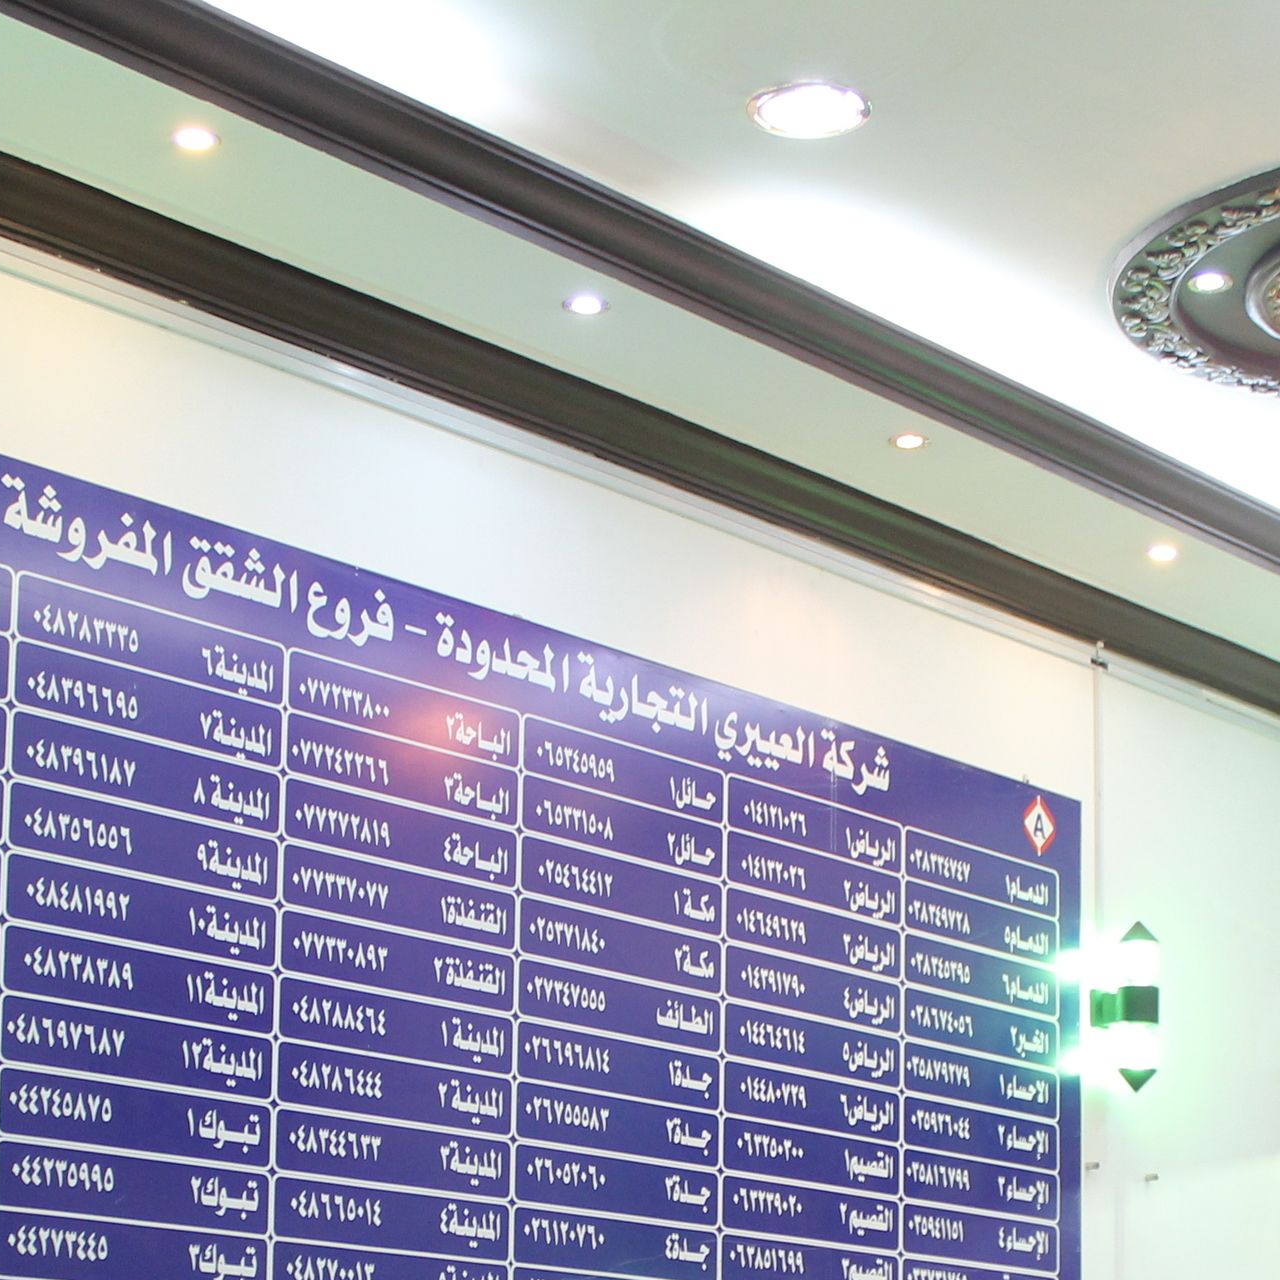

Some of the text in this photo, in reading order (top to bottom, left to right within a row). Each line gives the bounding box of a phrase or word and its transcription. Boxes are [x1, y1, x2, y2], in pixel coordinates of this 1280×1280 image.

[1, 474, 891, 795] شركة العييري التجارية المحدودة فروع الشقق المفروشة
[34, 604, 138, 652] ٠٤٨٢٨٣٣٣٥
[28, 671, 138, 719] ٠٤٨٣٩٦٦٩٥
[299, 677, 389, 719] ٠٧٧٢٣٣٨٠٠
[27, 739, 135, 786] ٠٤٨٣٩٦١٨٧
[292, 739, 389, 785] ٠٧٧٢٤٢٢٦٦
[537, 741, 615, 782] ٠٦٥٣٤٥٩٥٩
[25, 808, 132, 855] ٠٤٨٣٥٦٥٥٦
[295, 803, 390, 847] ٠٧٧٢٧٢٨١٩
[536, 800, 613, 840] ٠٦٥٣٣١٥٠٨
[292, 866, 388, 909] ٠٧٧٣٣٧٠٧٧
[539, 859, 613, 897] ٠٢٥٤٦٤٤١٢
[27, 877, 130, 920] ٠٤٨٤٨١٩٩٢
[293, 931, 388, 971] ٠٧٧٣٣٠٨٩٣
[530, 917, 605, 954] ٠٢٥٣٧١٨٤٠
[24, 946, 133, 990] ٠٤٨٢٣٨٣٨٩
[527, 976, 605, 1011] ٠٢٧٣٤٧٥٥٥
[7, 1014, 125, 1056] ٠٤٨٦٩٧٦٨٧
[292, 995, 386, 1035] ٠٤٨٢٨٨٤٦٤
[525, 1036, 609, 1073] ٠٢٦٦٩٦٨١٤
[292, 1060, 382, 1098] ٠٤٨٢٨٦٤٤٤
[10, 1084, 112, 1122] ٠٤٤٢٤٥٨٧٥
[526, 1096, 609, 1131] ٠٢٦٧٥٥٥٨٣
[289, 1125, 381, 1161] ٠٤٨٣٤٤٦٣٣
[12, 1155, 114, 1192] ٠٤٤٢٣٥٩٩٥
[527, 1157, 605, 1190] ٠٢٦٠٥٢٠٦٠
[291, 1190, 381, 1226] ٠٤٨٦٦٥٠١٤
[8, 1225, 108, 1261] ٠٤٤٢٧٣٤٤٥
[524, 1217, 604, 1249] ٠٢٦١٢٠٧٦٠
